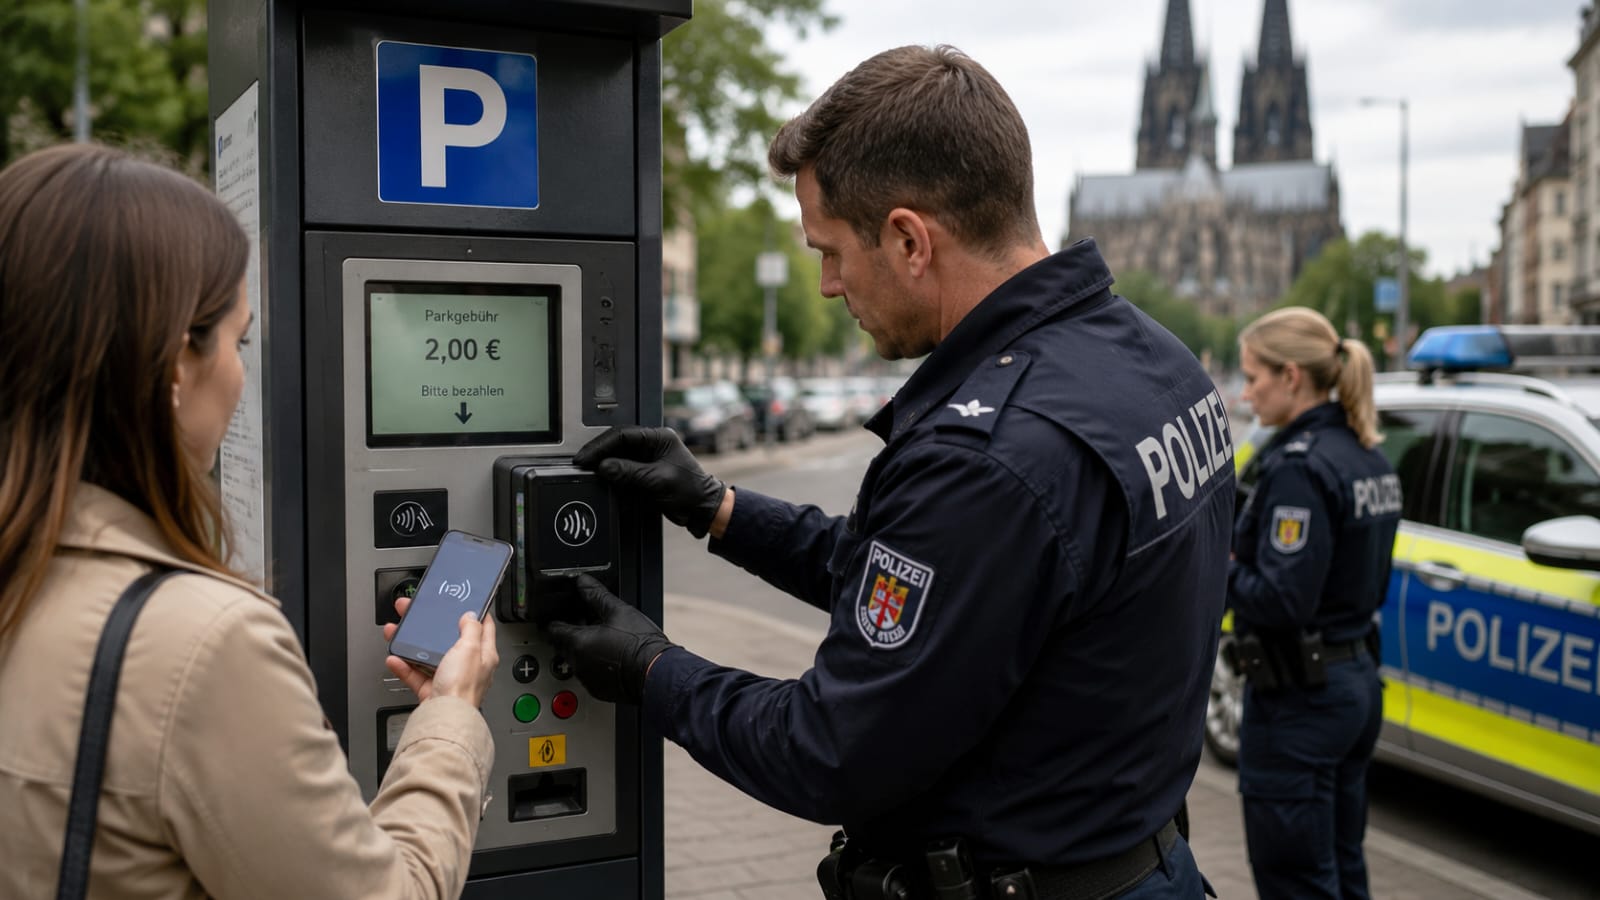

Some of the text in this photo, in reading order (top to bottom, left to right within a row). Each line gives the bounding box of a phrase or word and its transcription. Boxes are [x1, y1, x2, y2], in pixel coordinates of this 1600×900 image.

[419, 64, 508, 188] P
[425, 309, 499, 325] Parkgebühr
[425, 338, 501, 364] 2,00 €
[421, 385, 504, 397] Bitte bezahlen
[1352, 474, 1403, 519] POLIZE
[872, 547, 927, 589] POLIZEI
